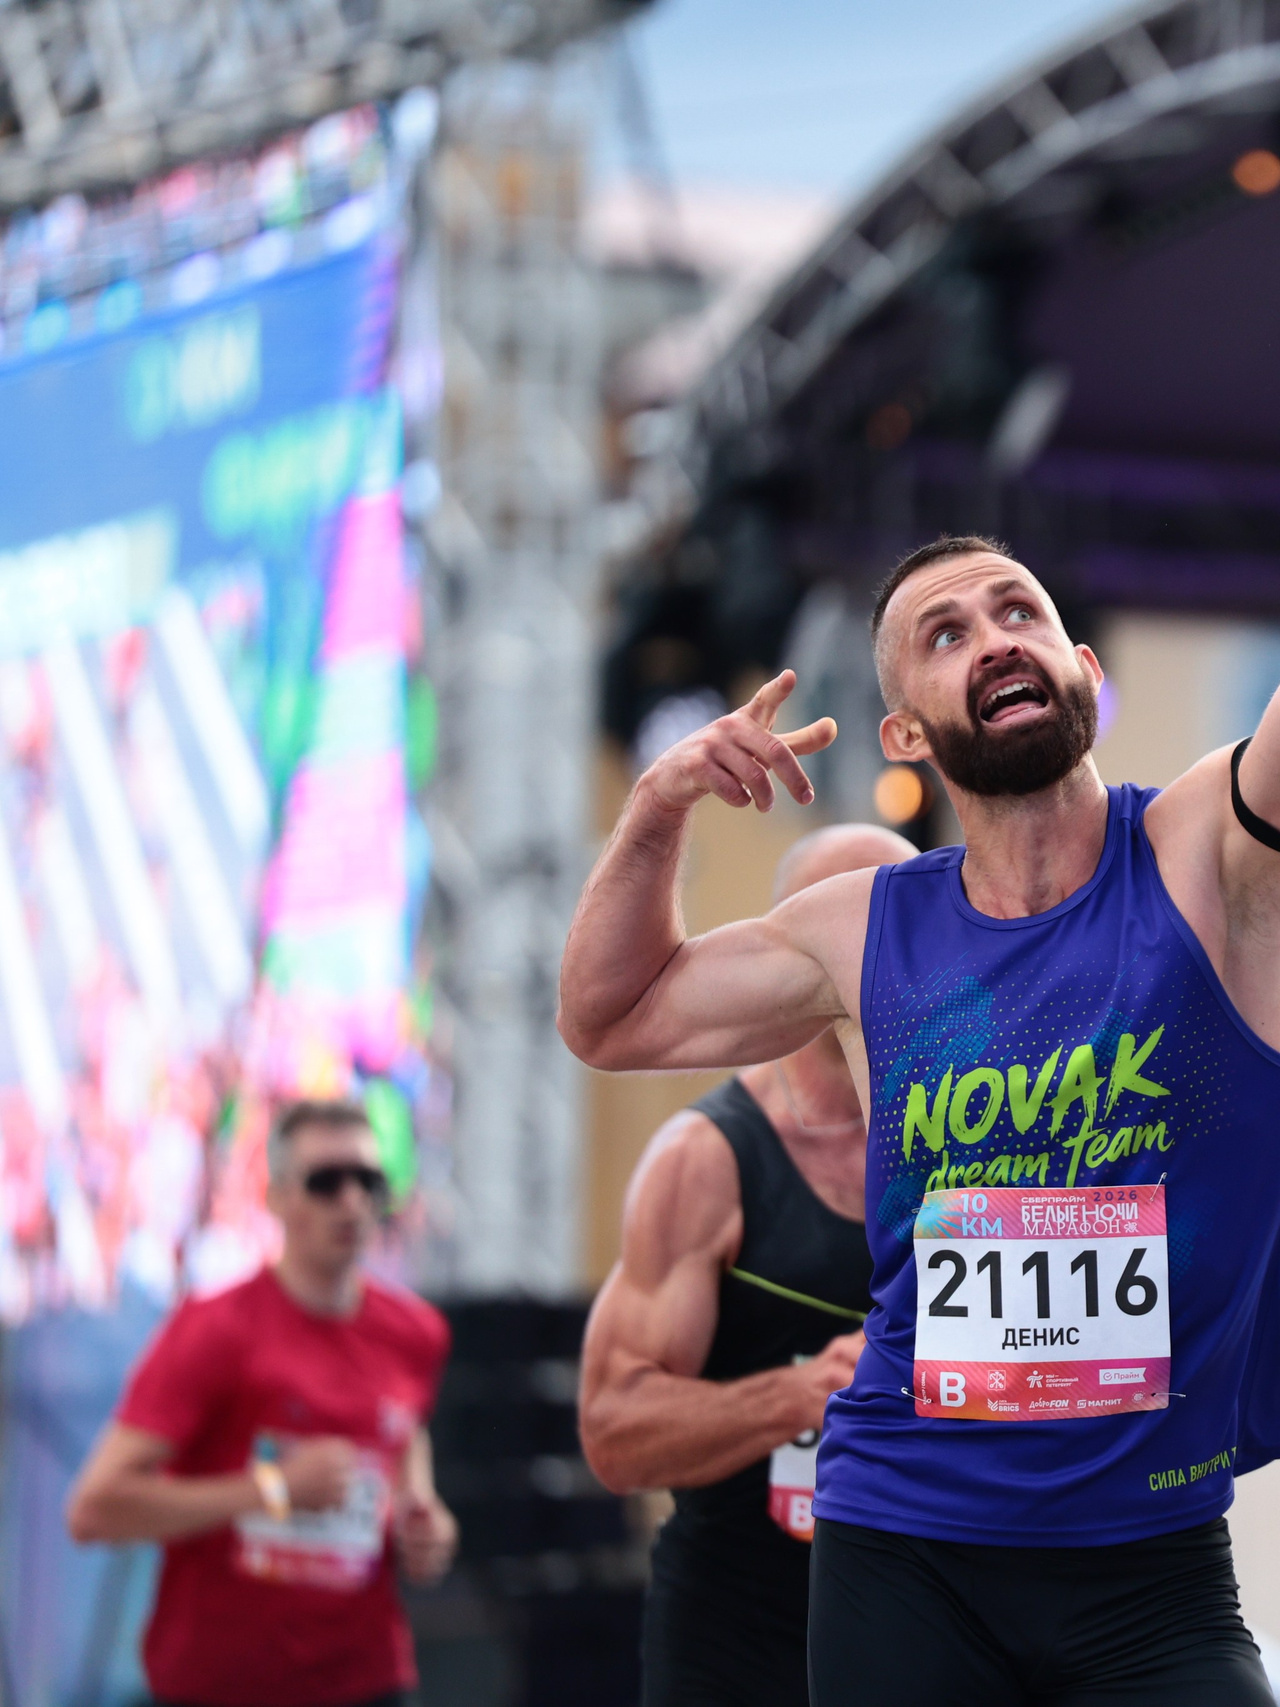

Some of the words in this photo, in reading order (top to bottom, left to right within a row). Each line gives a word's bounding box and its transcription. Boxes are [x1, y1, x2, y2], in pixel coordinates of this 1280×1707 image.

[902, 1023, 1171, 1163] NOVAK
[925, 1150, 1049, 1192] dream
[961, 1194, 988, 1213] 10
[1093, 1190, 1138, 1202] 2026
[1021, 1205, 1078, 1223] БЕЛЫЕ
[1082, 1203, 1139, 1221] НОЧИ
[1023, 1219, 1121, 1236] МАРАФОН
[928, 1248, 1159, 1319] 21116
[1002, 1327, 1080, 1350] ДЕНИС
[1113, 1372, 1140, 1380] Прайм
[1087, 1399, 1122, 1407] МАГНИТ
[1149, 1468, 1186, 1491] СИЛА
[1190, 1450, 1231, 1482] ВНУТРИ
